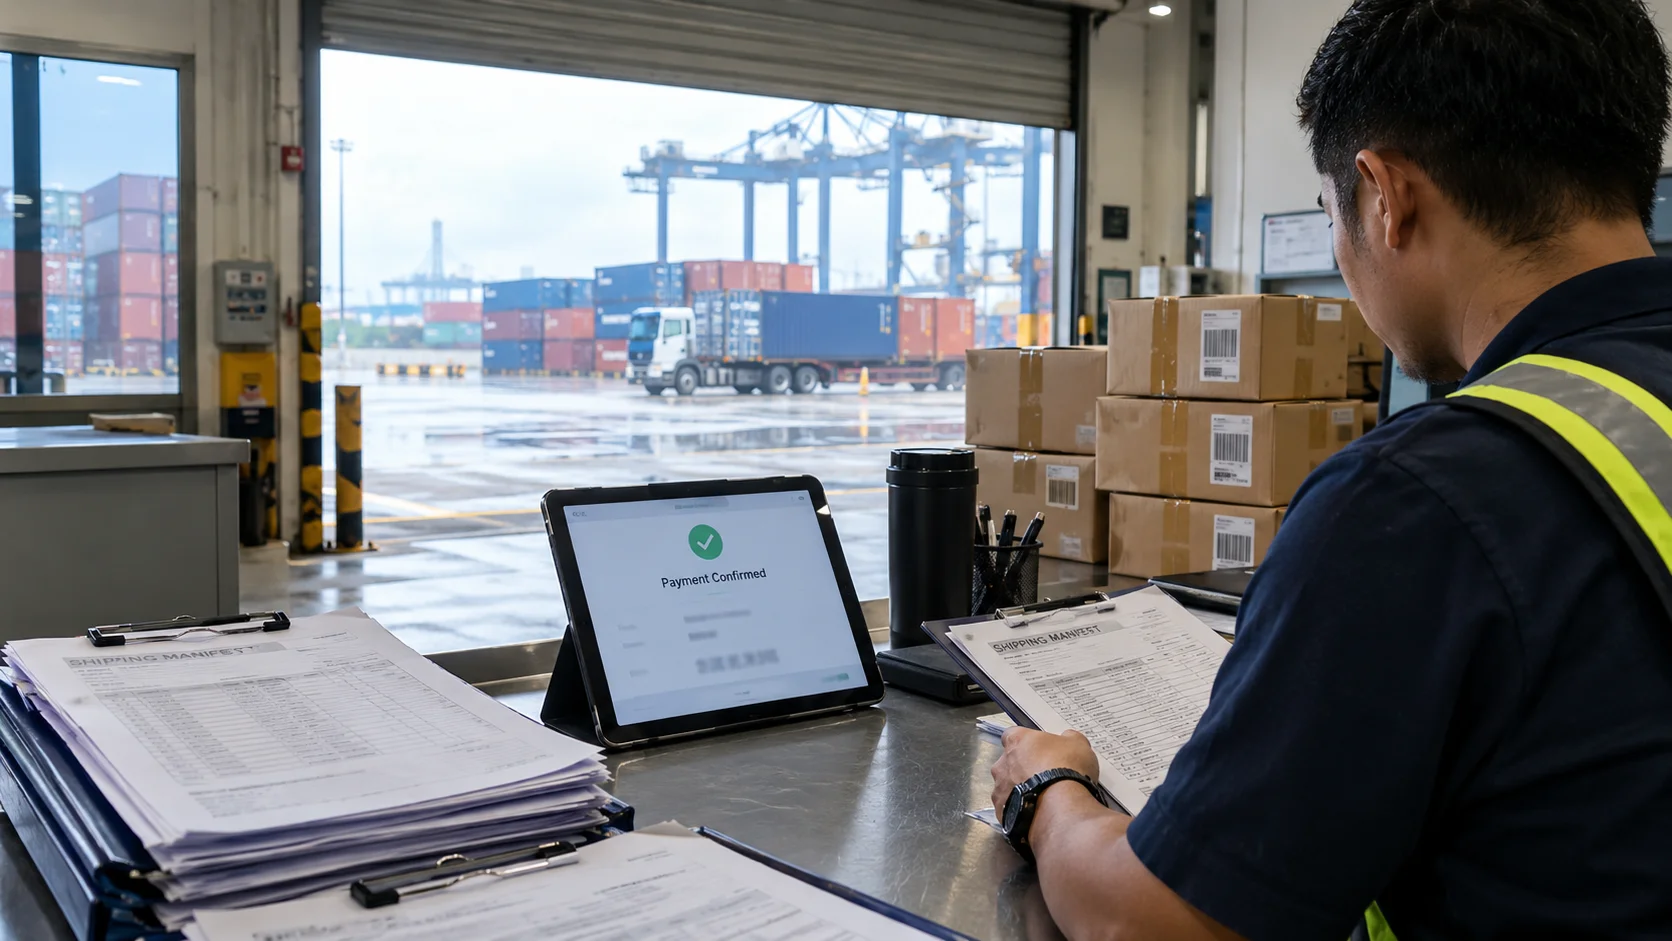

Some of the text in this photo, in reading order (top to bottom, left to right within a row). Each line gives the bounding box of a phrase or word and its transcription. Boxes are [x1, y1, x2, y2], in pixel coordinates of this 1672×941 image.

[661, 568, 767, 590] Payment Confirmed
[993, 636, 1048, 653] SHIPPING
